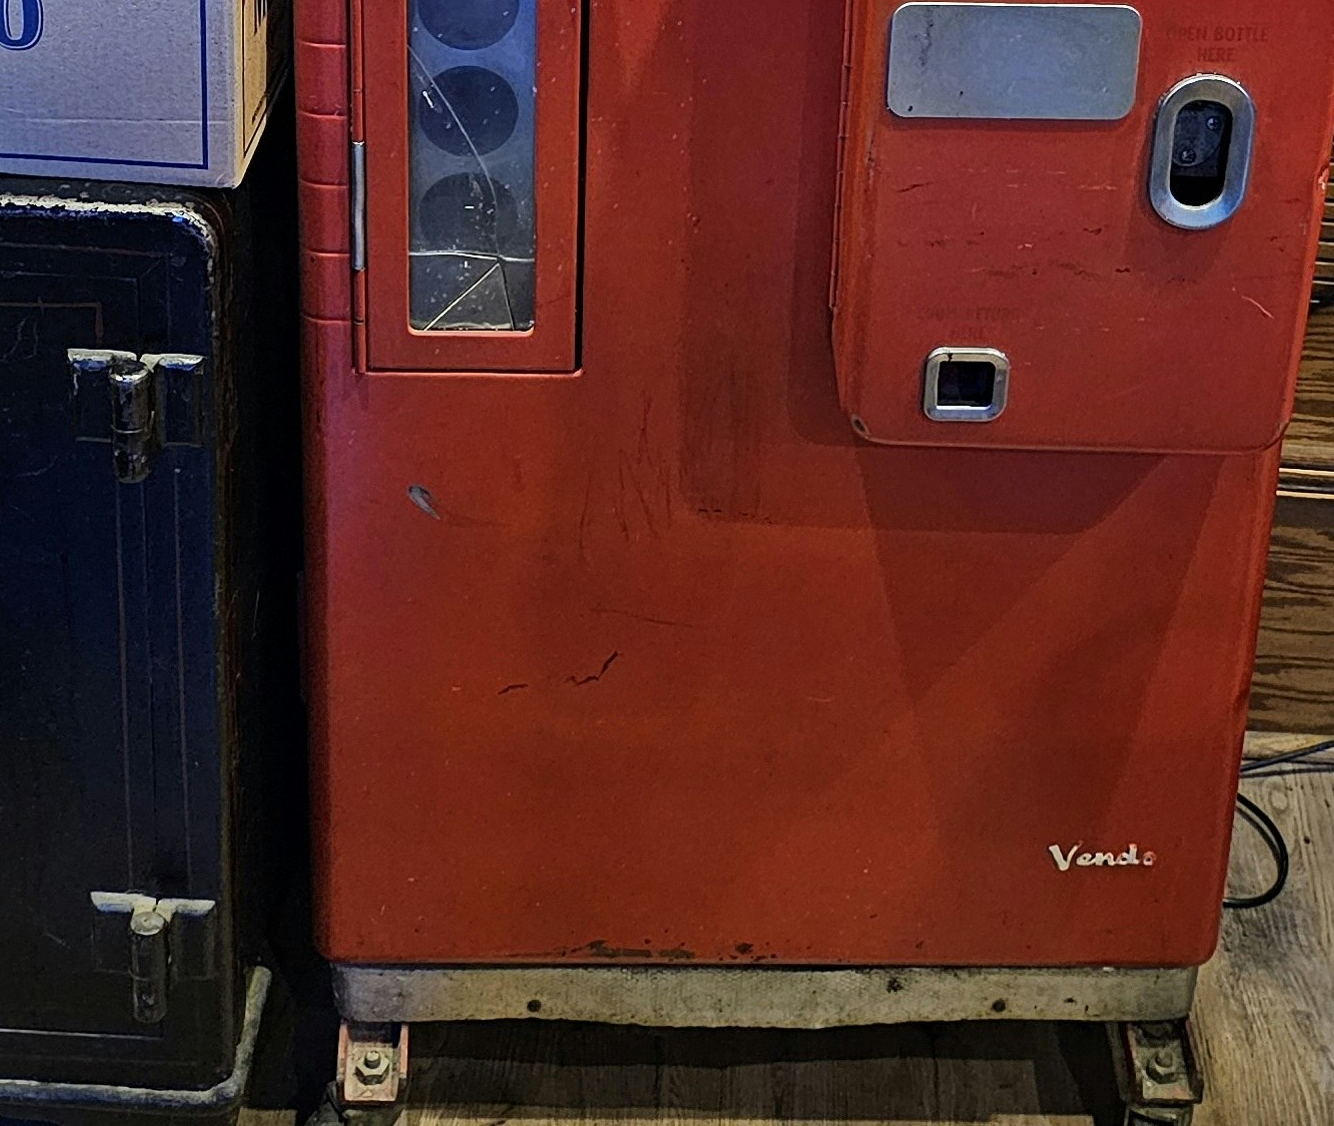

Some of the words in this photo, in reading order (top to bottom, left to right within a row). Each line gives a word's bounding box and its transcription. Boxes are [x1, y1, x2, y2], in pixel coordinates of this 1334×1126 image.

[1213, 26, 1269, 42] BOTTLE
[1197, 47, 1237, 62] HERE
[1048, 840, 1157, 872] Vendo
